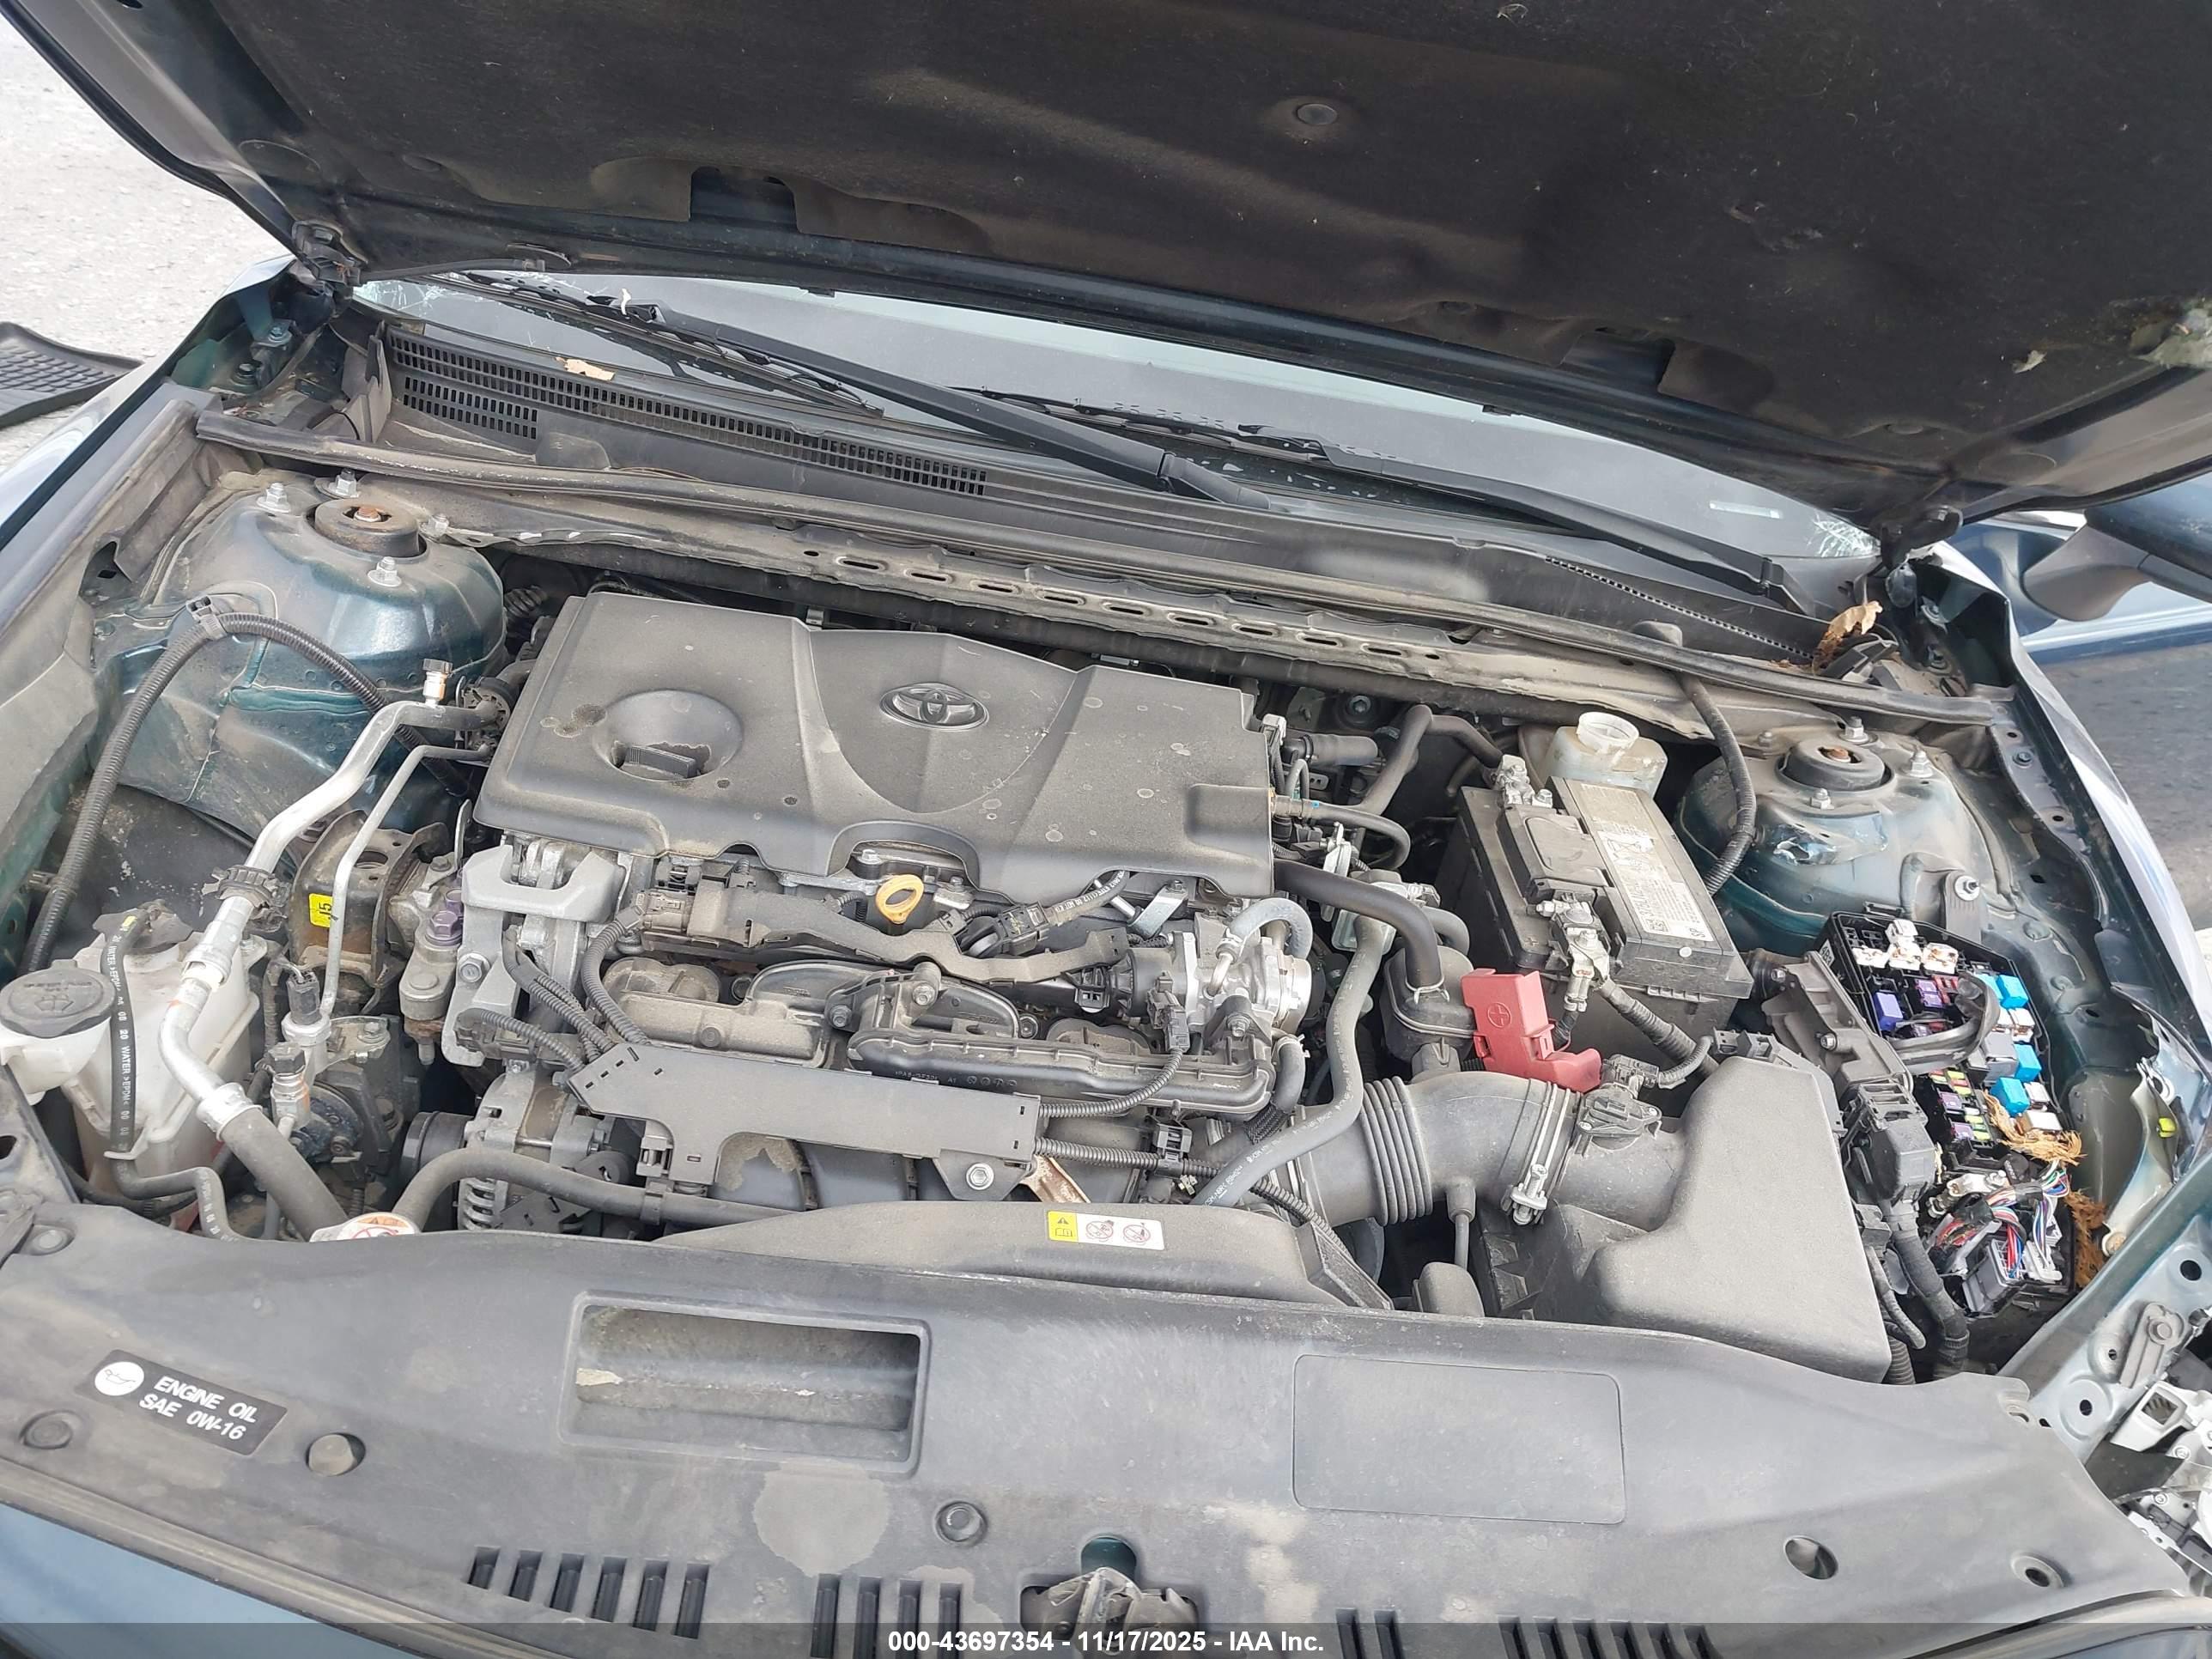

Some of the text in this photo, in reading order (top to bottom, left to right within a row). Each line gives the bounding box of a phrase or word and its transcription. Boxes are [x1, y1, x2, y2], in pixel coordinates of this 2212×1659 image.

[106, 945, 118, 966] WATER
[119, 1029, 130, 1040] 20
[121, 1045, 131, 1075] WATER
[154, 1376, 258, 1423] ENGINE OIL
[139, 1394, 247, 1440] SAE 0W-16
